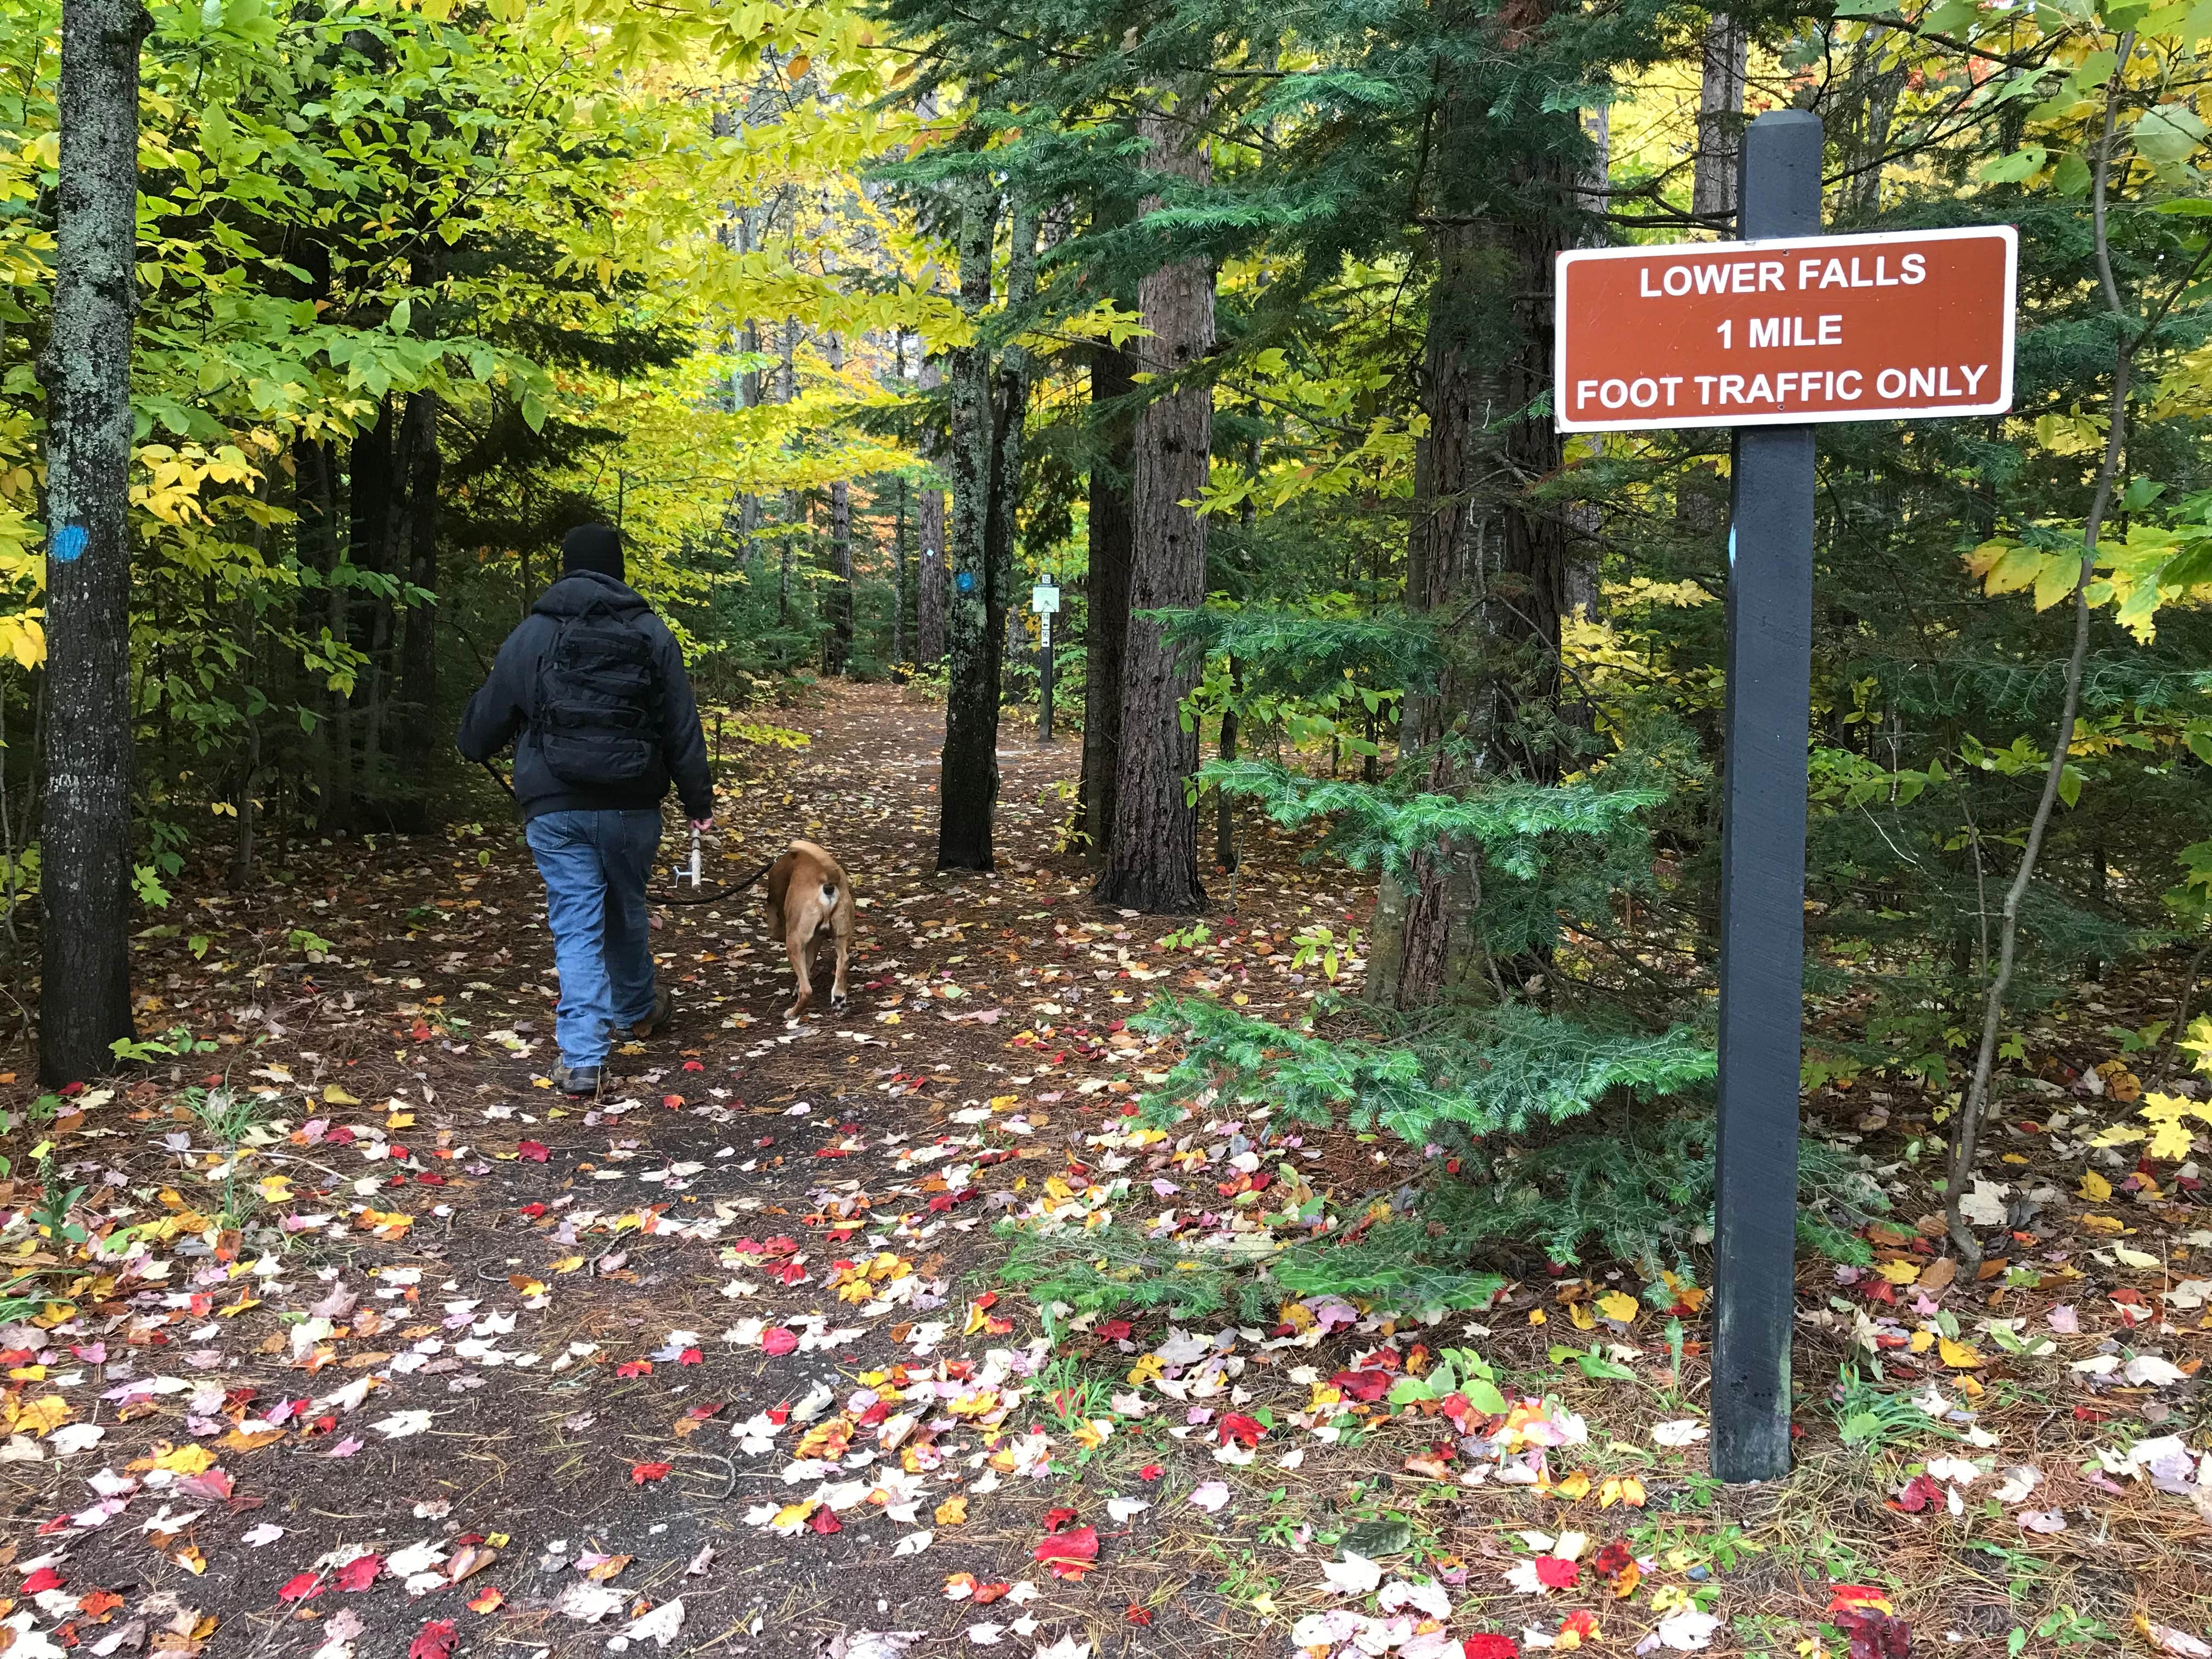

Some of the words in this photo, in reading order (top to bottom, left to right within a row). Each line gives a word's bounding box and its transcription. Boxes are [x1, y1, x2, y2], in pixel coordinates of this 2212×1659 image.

[1640, 261, 1786, 297] LOWER
[1798, 253, 1926, 290] FALLS
[1717, 319, 1732, 349] 1
[1748, 314, 1843, 348] MILE
[1577, 377, 1683, 409] FOOT
[1694, 370, 1863, 406] TRAFFIC
[1876, 364, 1989, 399] ONLY
